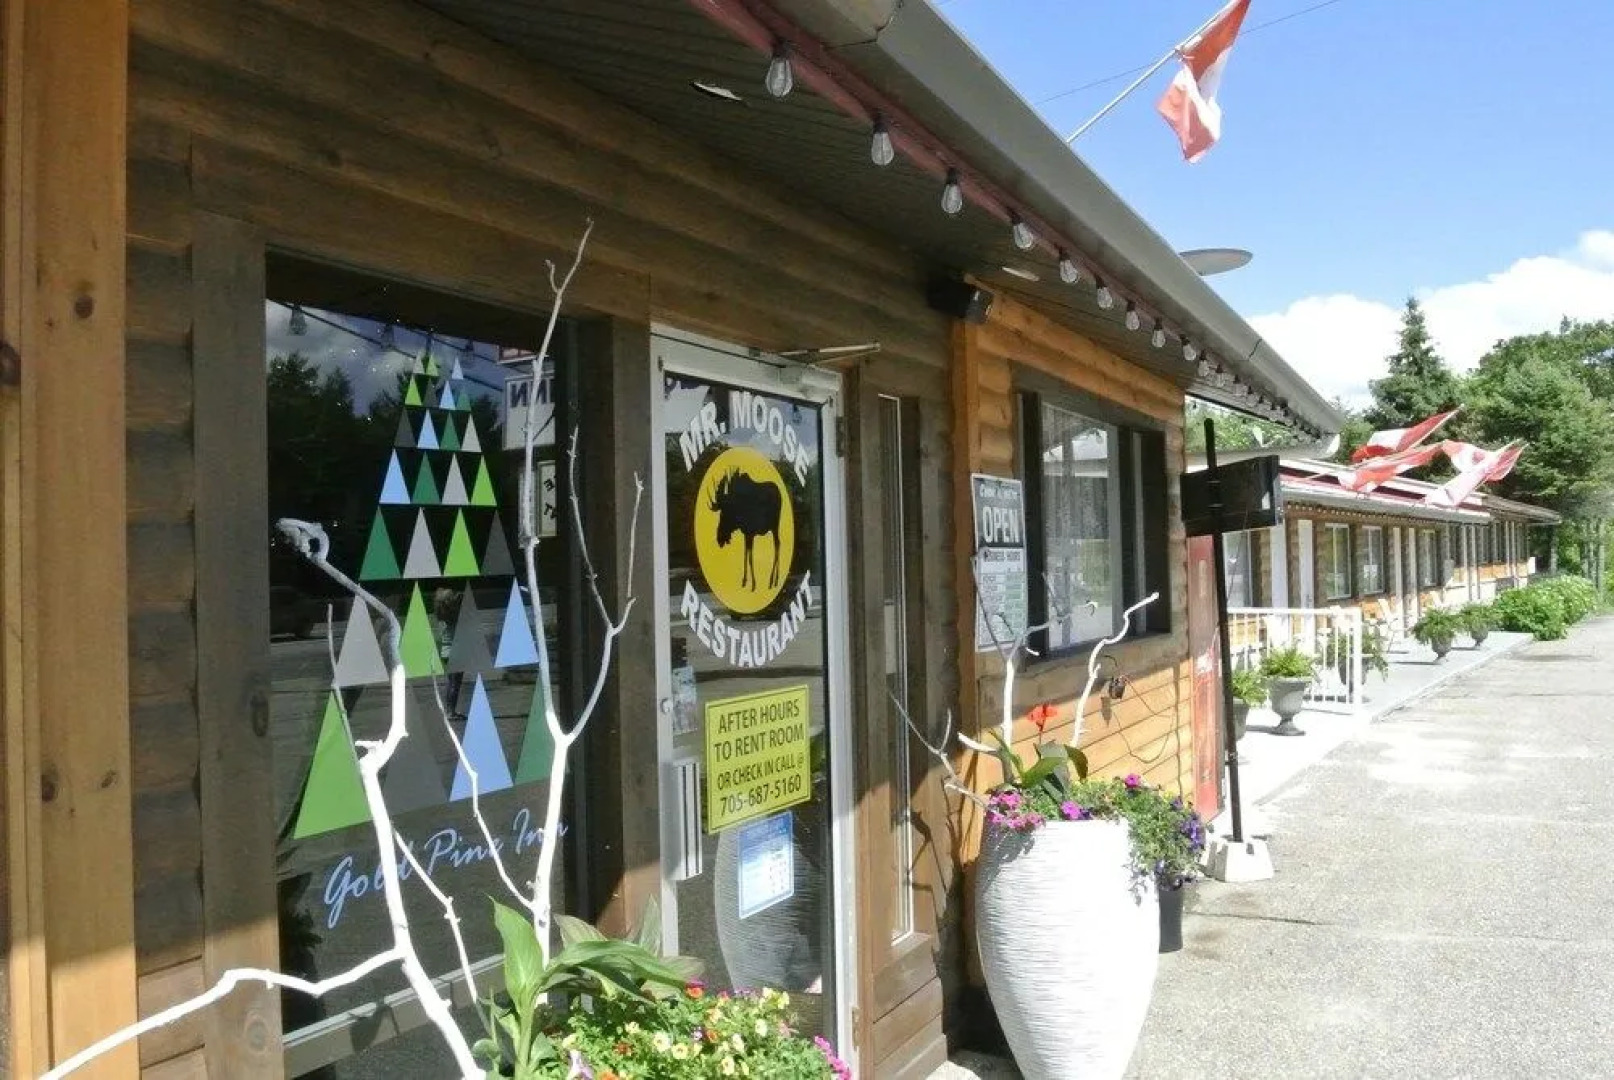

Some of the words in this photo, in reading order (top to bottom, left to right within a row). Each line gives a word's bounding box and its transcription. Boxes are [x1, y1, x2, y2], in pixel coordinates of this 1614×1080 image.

[679, 400, 727, 471] MR.
[731, 391, 810, 487] MOOSE
[982, 506, 1020, 543] OPEN
[680, 569, 813, 668] RESTAURANT
[718, 708, 757, 734] AFTER
[760, 698, 800, 724] HOURS
[714, 741, 732, 763] TO
[735, 731, 766, 757] RENT
[769, 724, 804, 747] ROOM
[717, 771, 731, 791] OR
[734, 763, 763, 786] CHECK
[764, 762, 774, 777] IN
[776, 754, 795, 774] CALL
[720, 773, 802, 817] 705-687-5160
